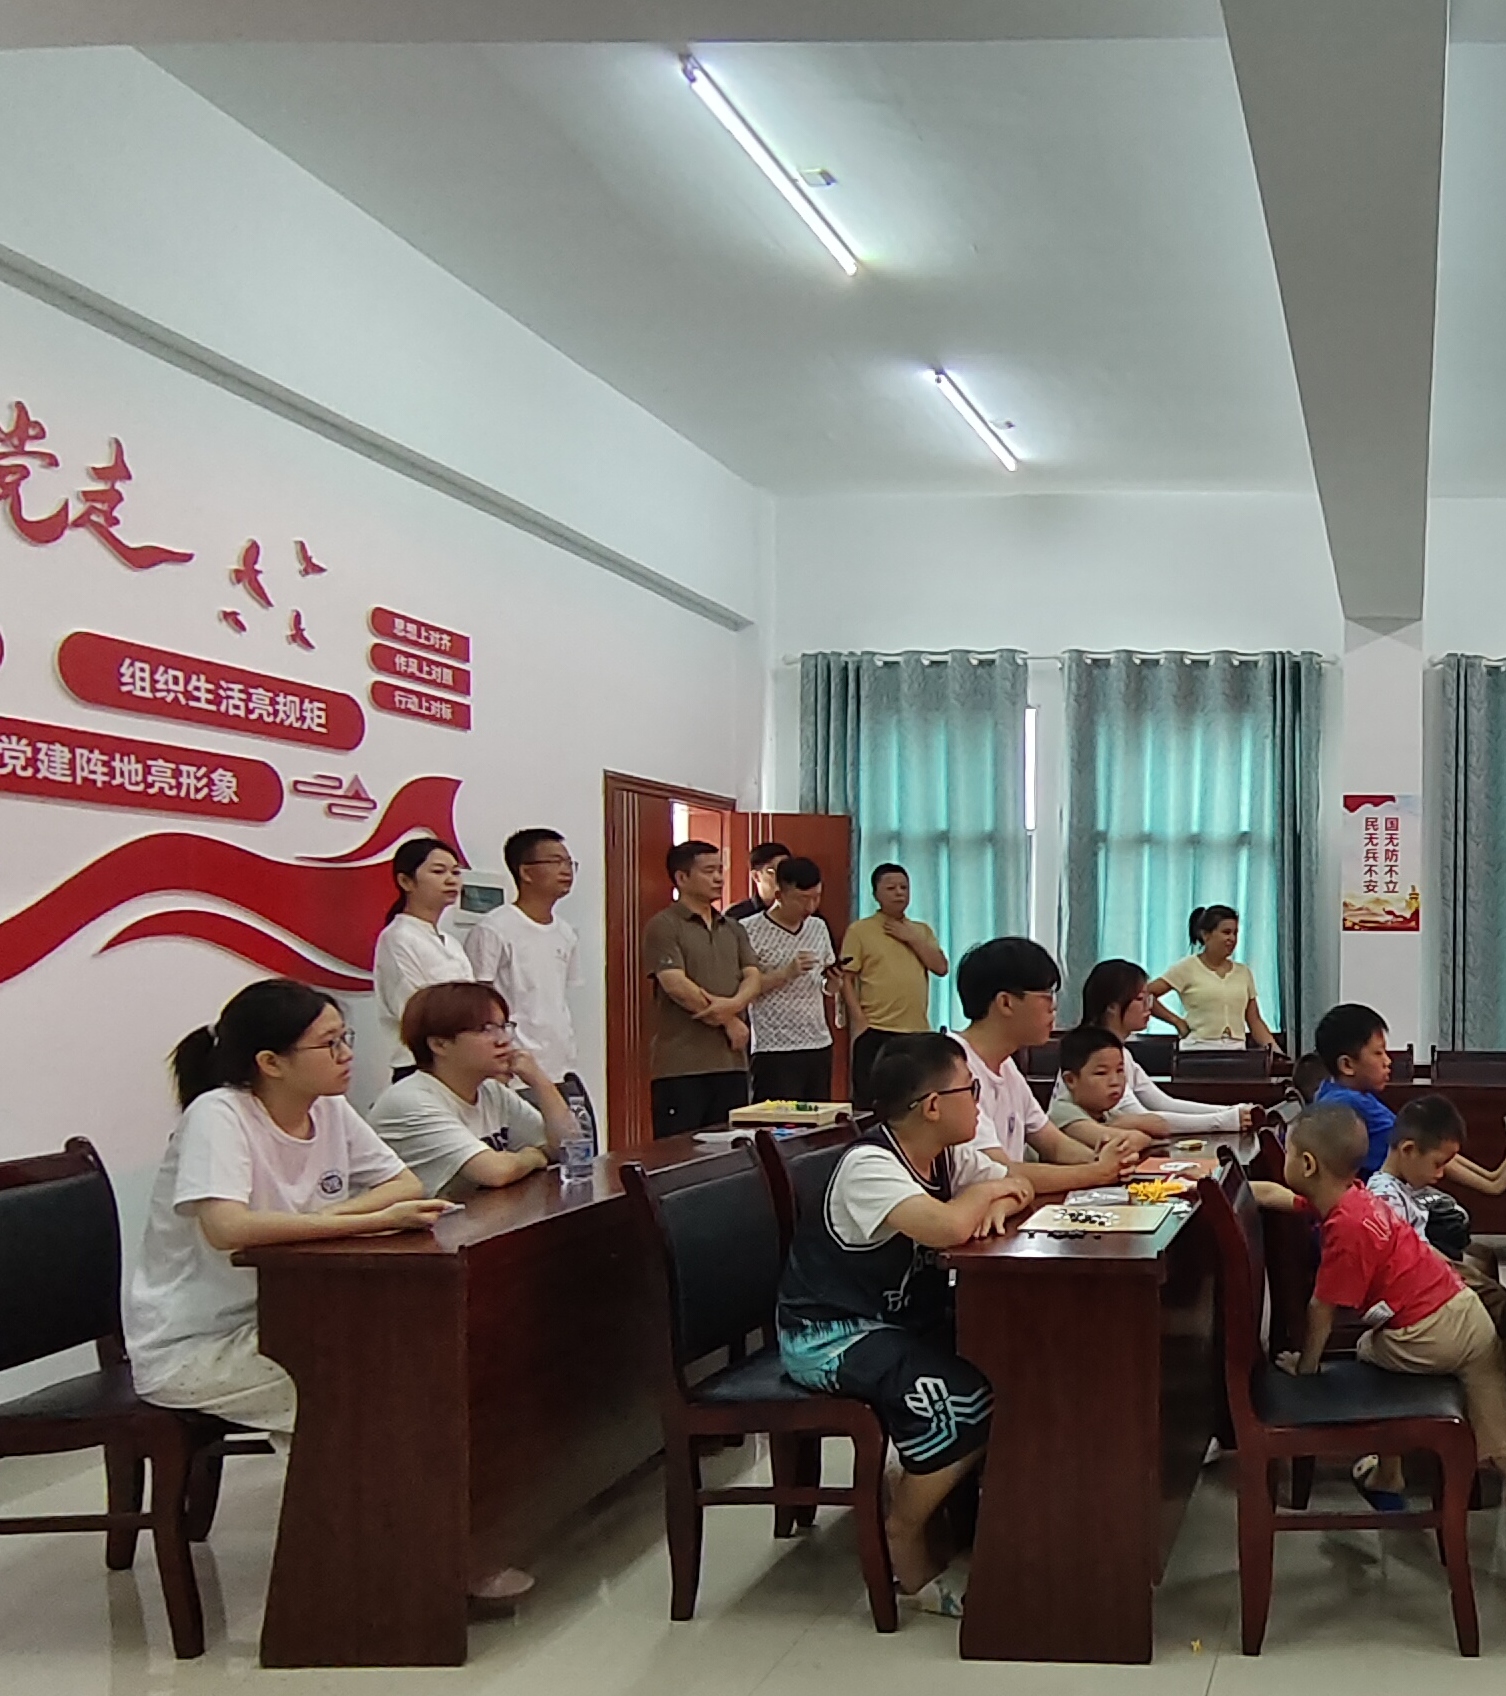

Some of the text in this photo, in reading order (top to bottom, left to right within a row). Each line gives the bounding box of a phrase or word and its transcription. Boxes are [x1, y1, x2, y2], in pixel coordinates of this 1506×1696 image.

[393, 618, 452, 652] 思想上对齐
[119, 657, 328, 734] 组织生活亮规矩
[393, 690, 453, 721] 行动上对标
[0, 734, 240, 805] 党建阵地亮形象
[1362, 816, 1380, 894] 民无兵不安
[1383, 816, 1400, 894] 国无防不立
